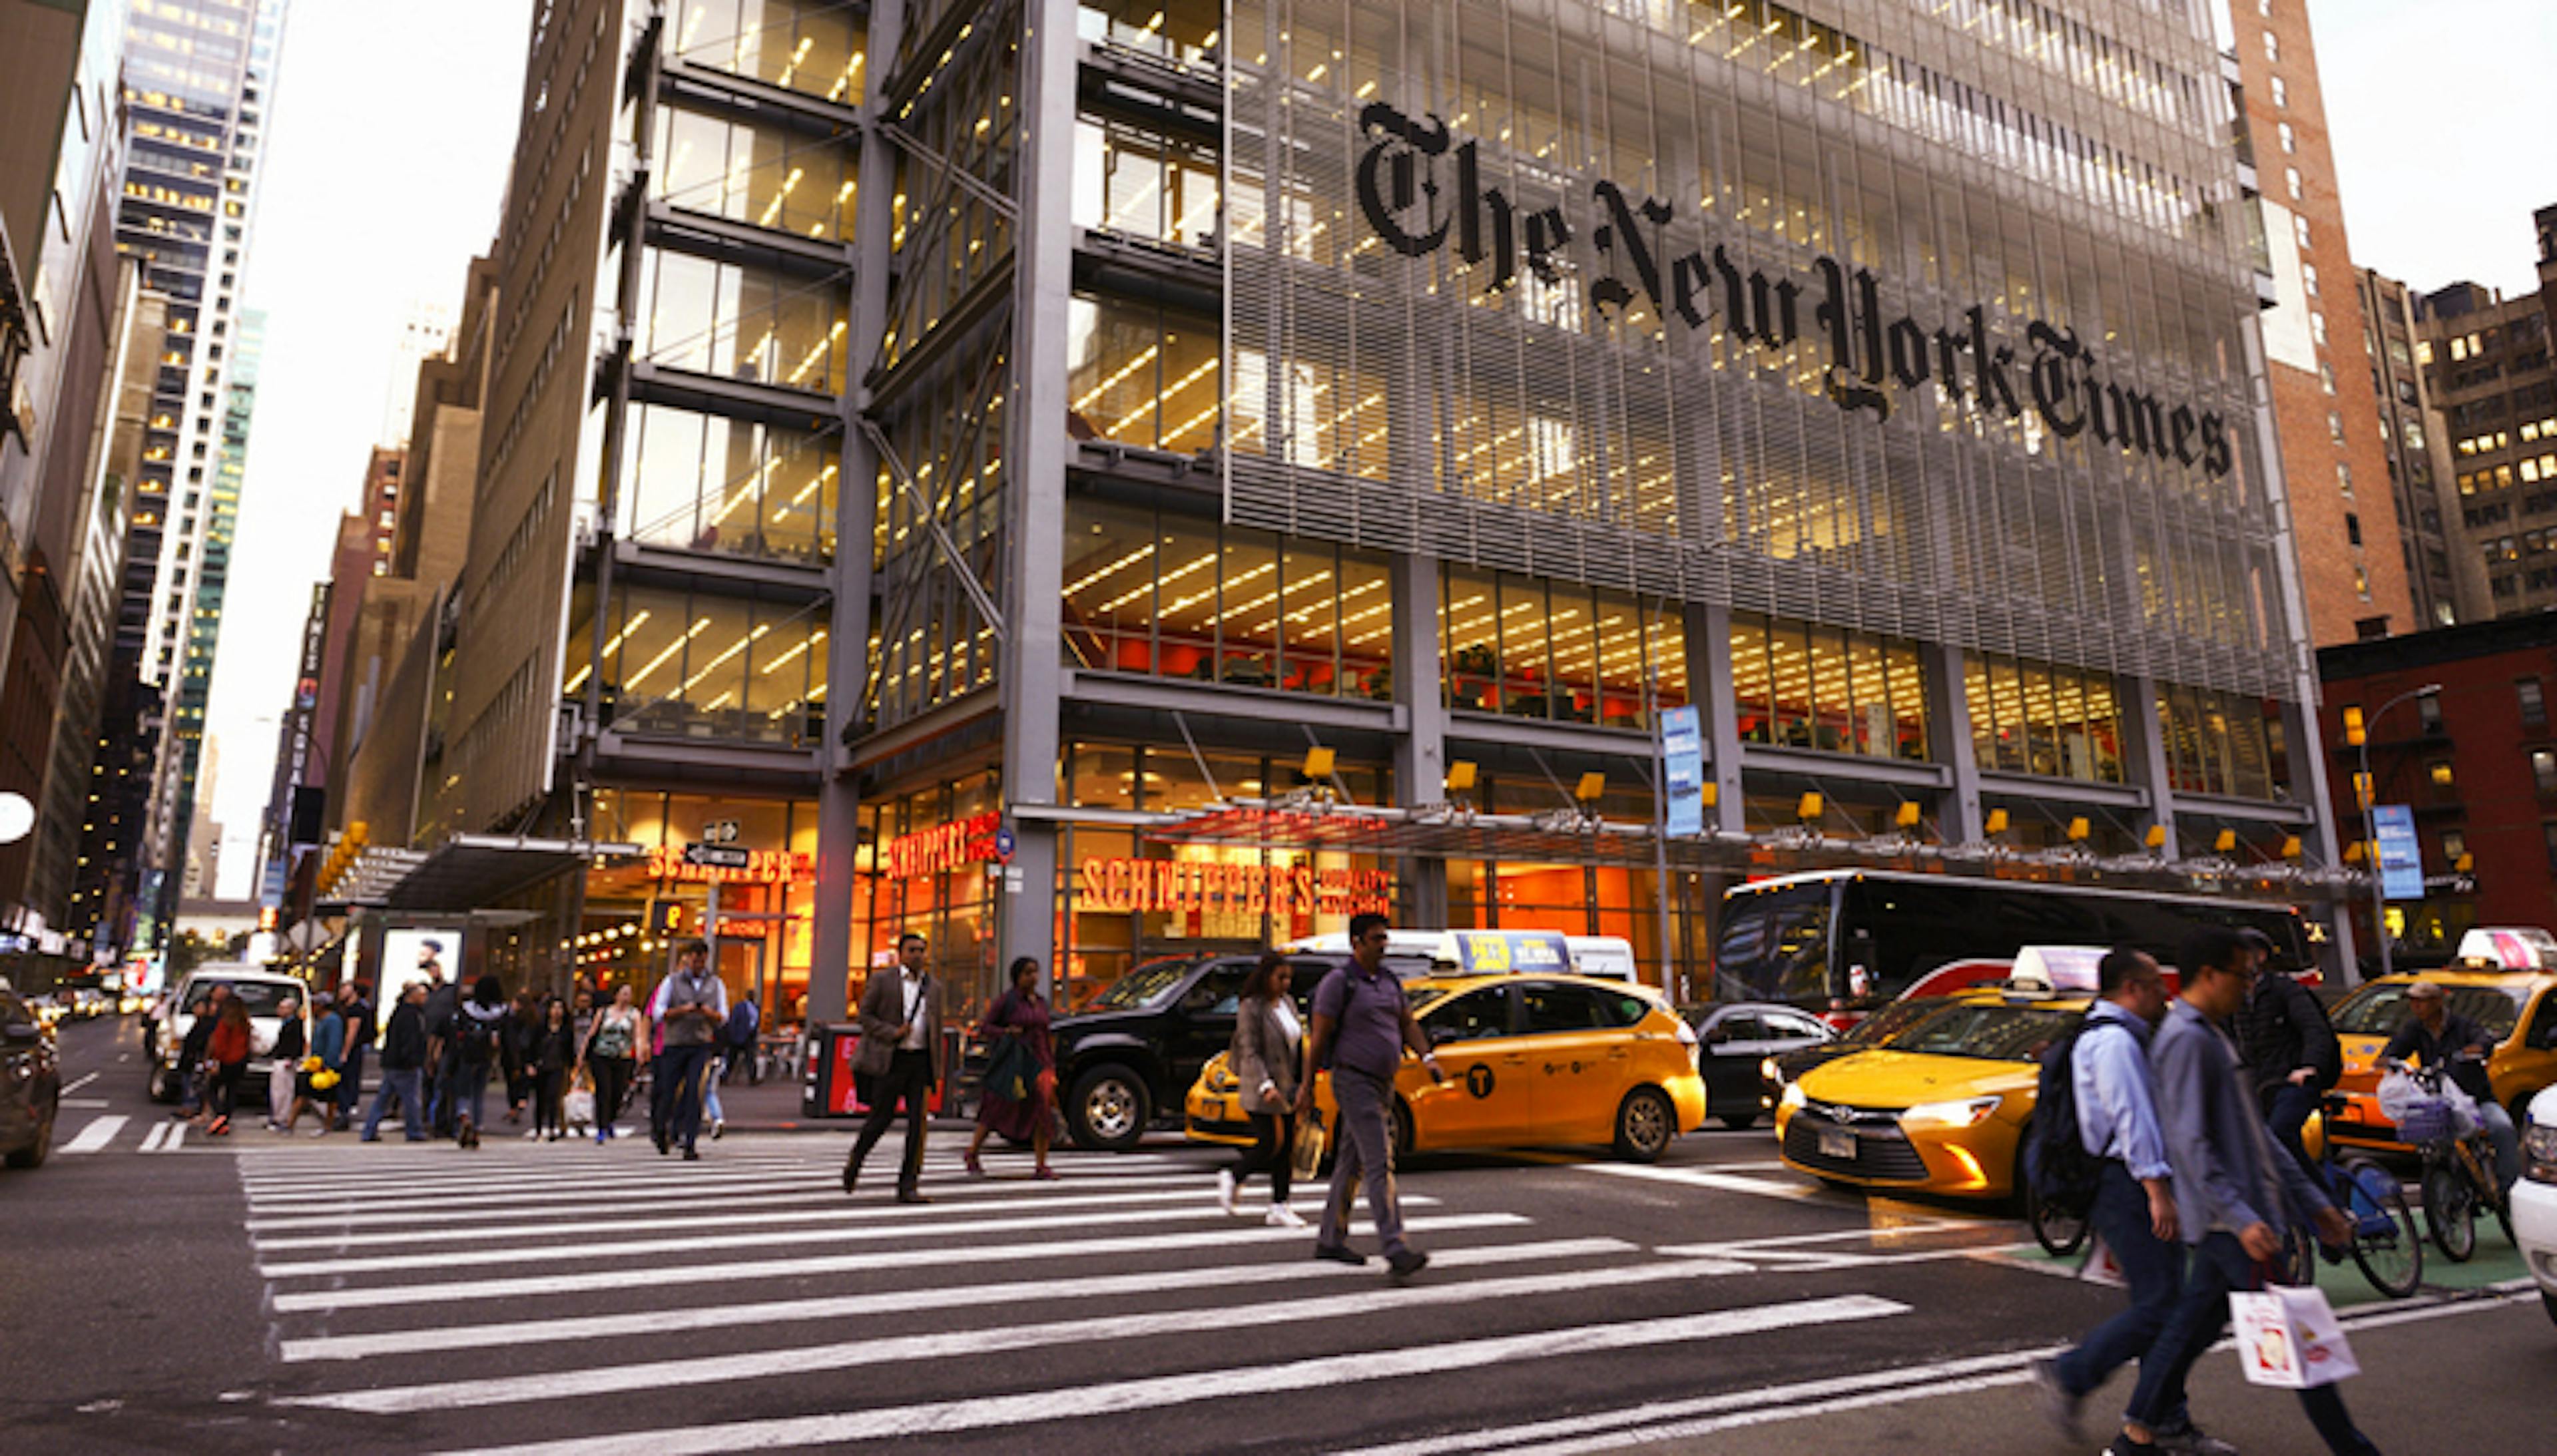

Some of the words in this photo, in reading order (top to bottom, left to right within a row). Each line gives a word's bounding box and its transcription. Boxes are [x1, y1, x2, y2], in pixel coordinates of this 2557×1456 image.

[1356, 101, 1571, 294] The
[1589, 179, 1803, 352] New
[1812, 255, 2020, 424] York
[2027, 320, 2231, 481] Times
[1081, 855, 1315, 916] SCHNIPPER'S
